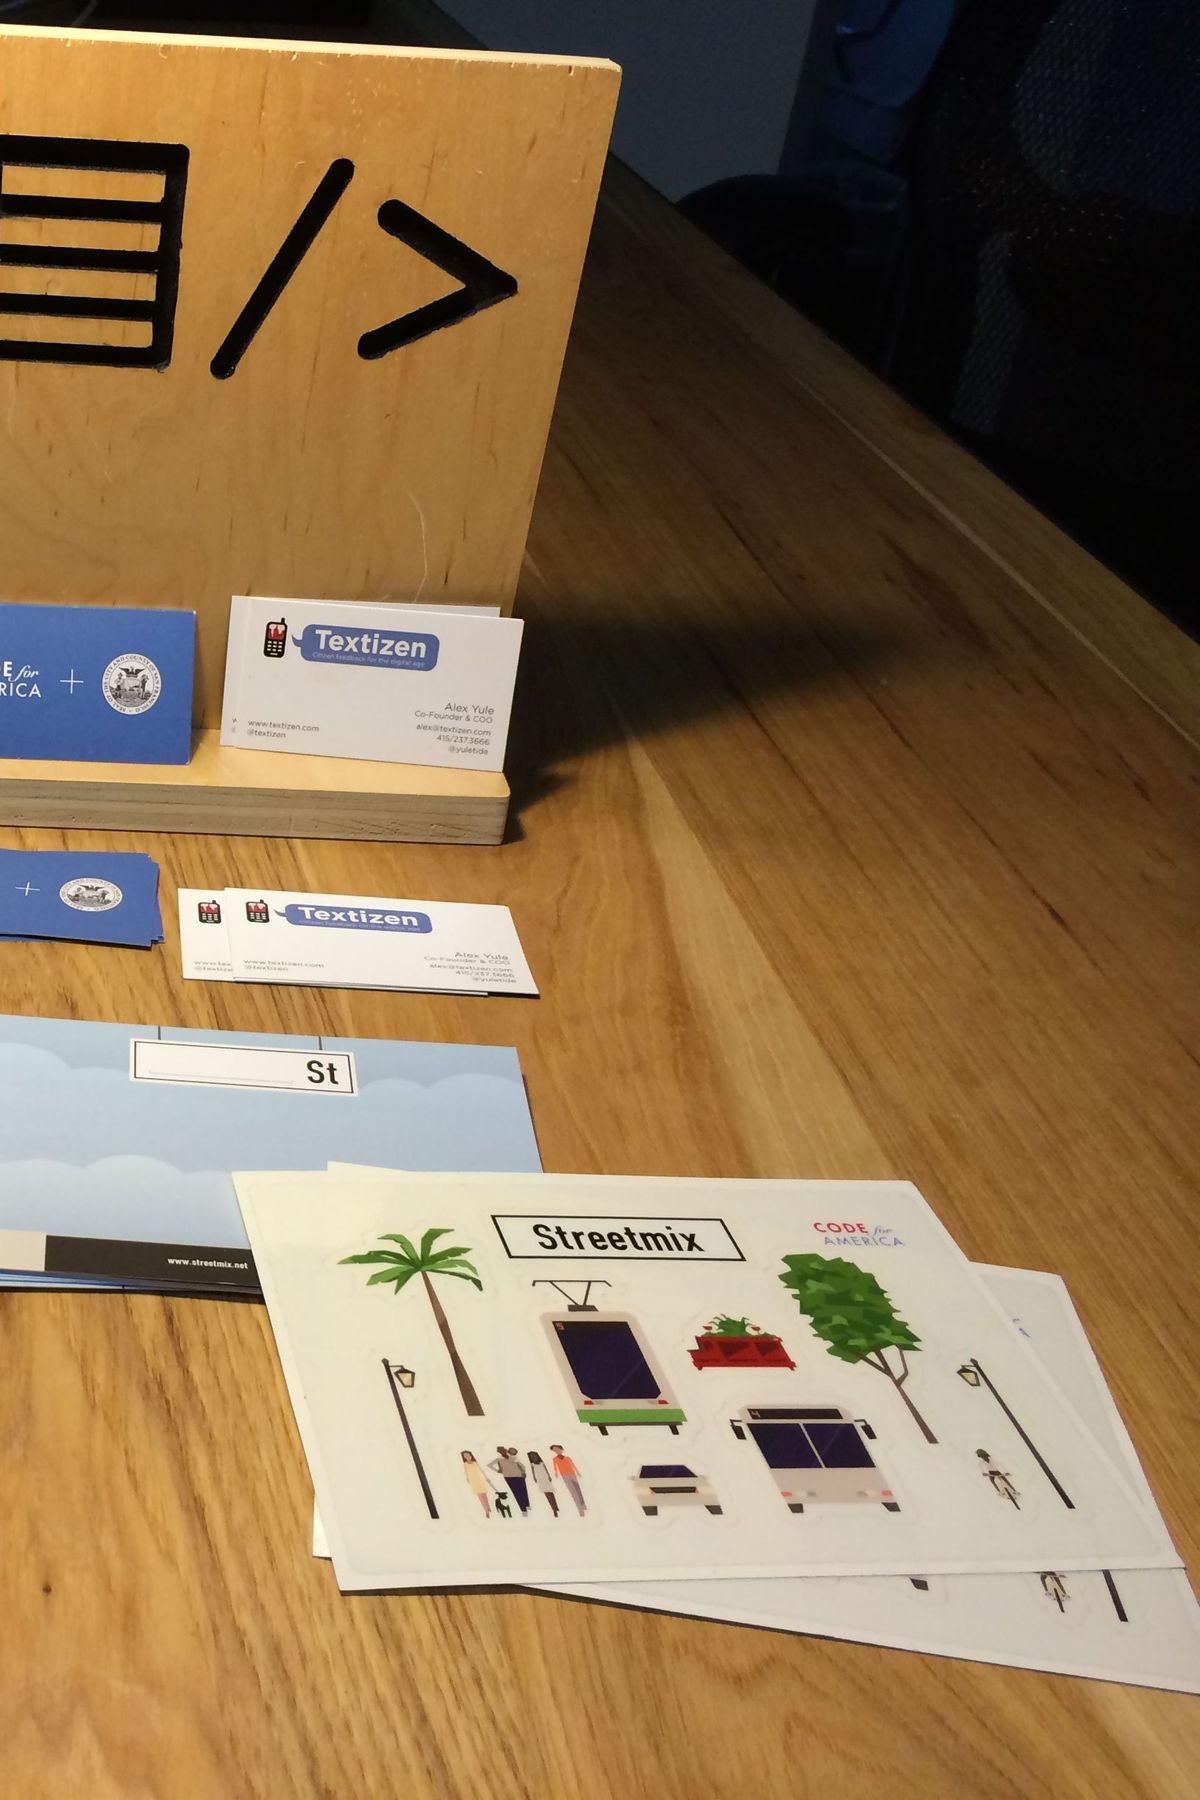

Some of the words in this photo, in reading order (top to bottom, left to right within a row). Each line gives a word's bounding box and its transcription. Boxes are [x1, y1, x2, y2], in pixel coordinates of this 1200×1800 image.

[315, 629, 427, 658] Textizen
[8, 664, 39, 682] for
[445, 702, 468, 713] Alex
[472, 705, 494, 716] Yule
[414, 710, 463, 721] Co-Founder
[473, 715, 493, 724] COO
[248, 720, 320, 732] www.textizen.com
[298, 906, 419, 926] Textizen
[306, 1060, 339, 1085] St
[813, 1222, 869, 1233] CODE
[532, 1223, 705, 1253] Streetmix
[824, 1236, 906, 1247] AMERICA
[168, 1258, 248, 1269] www.streetmix.net
